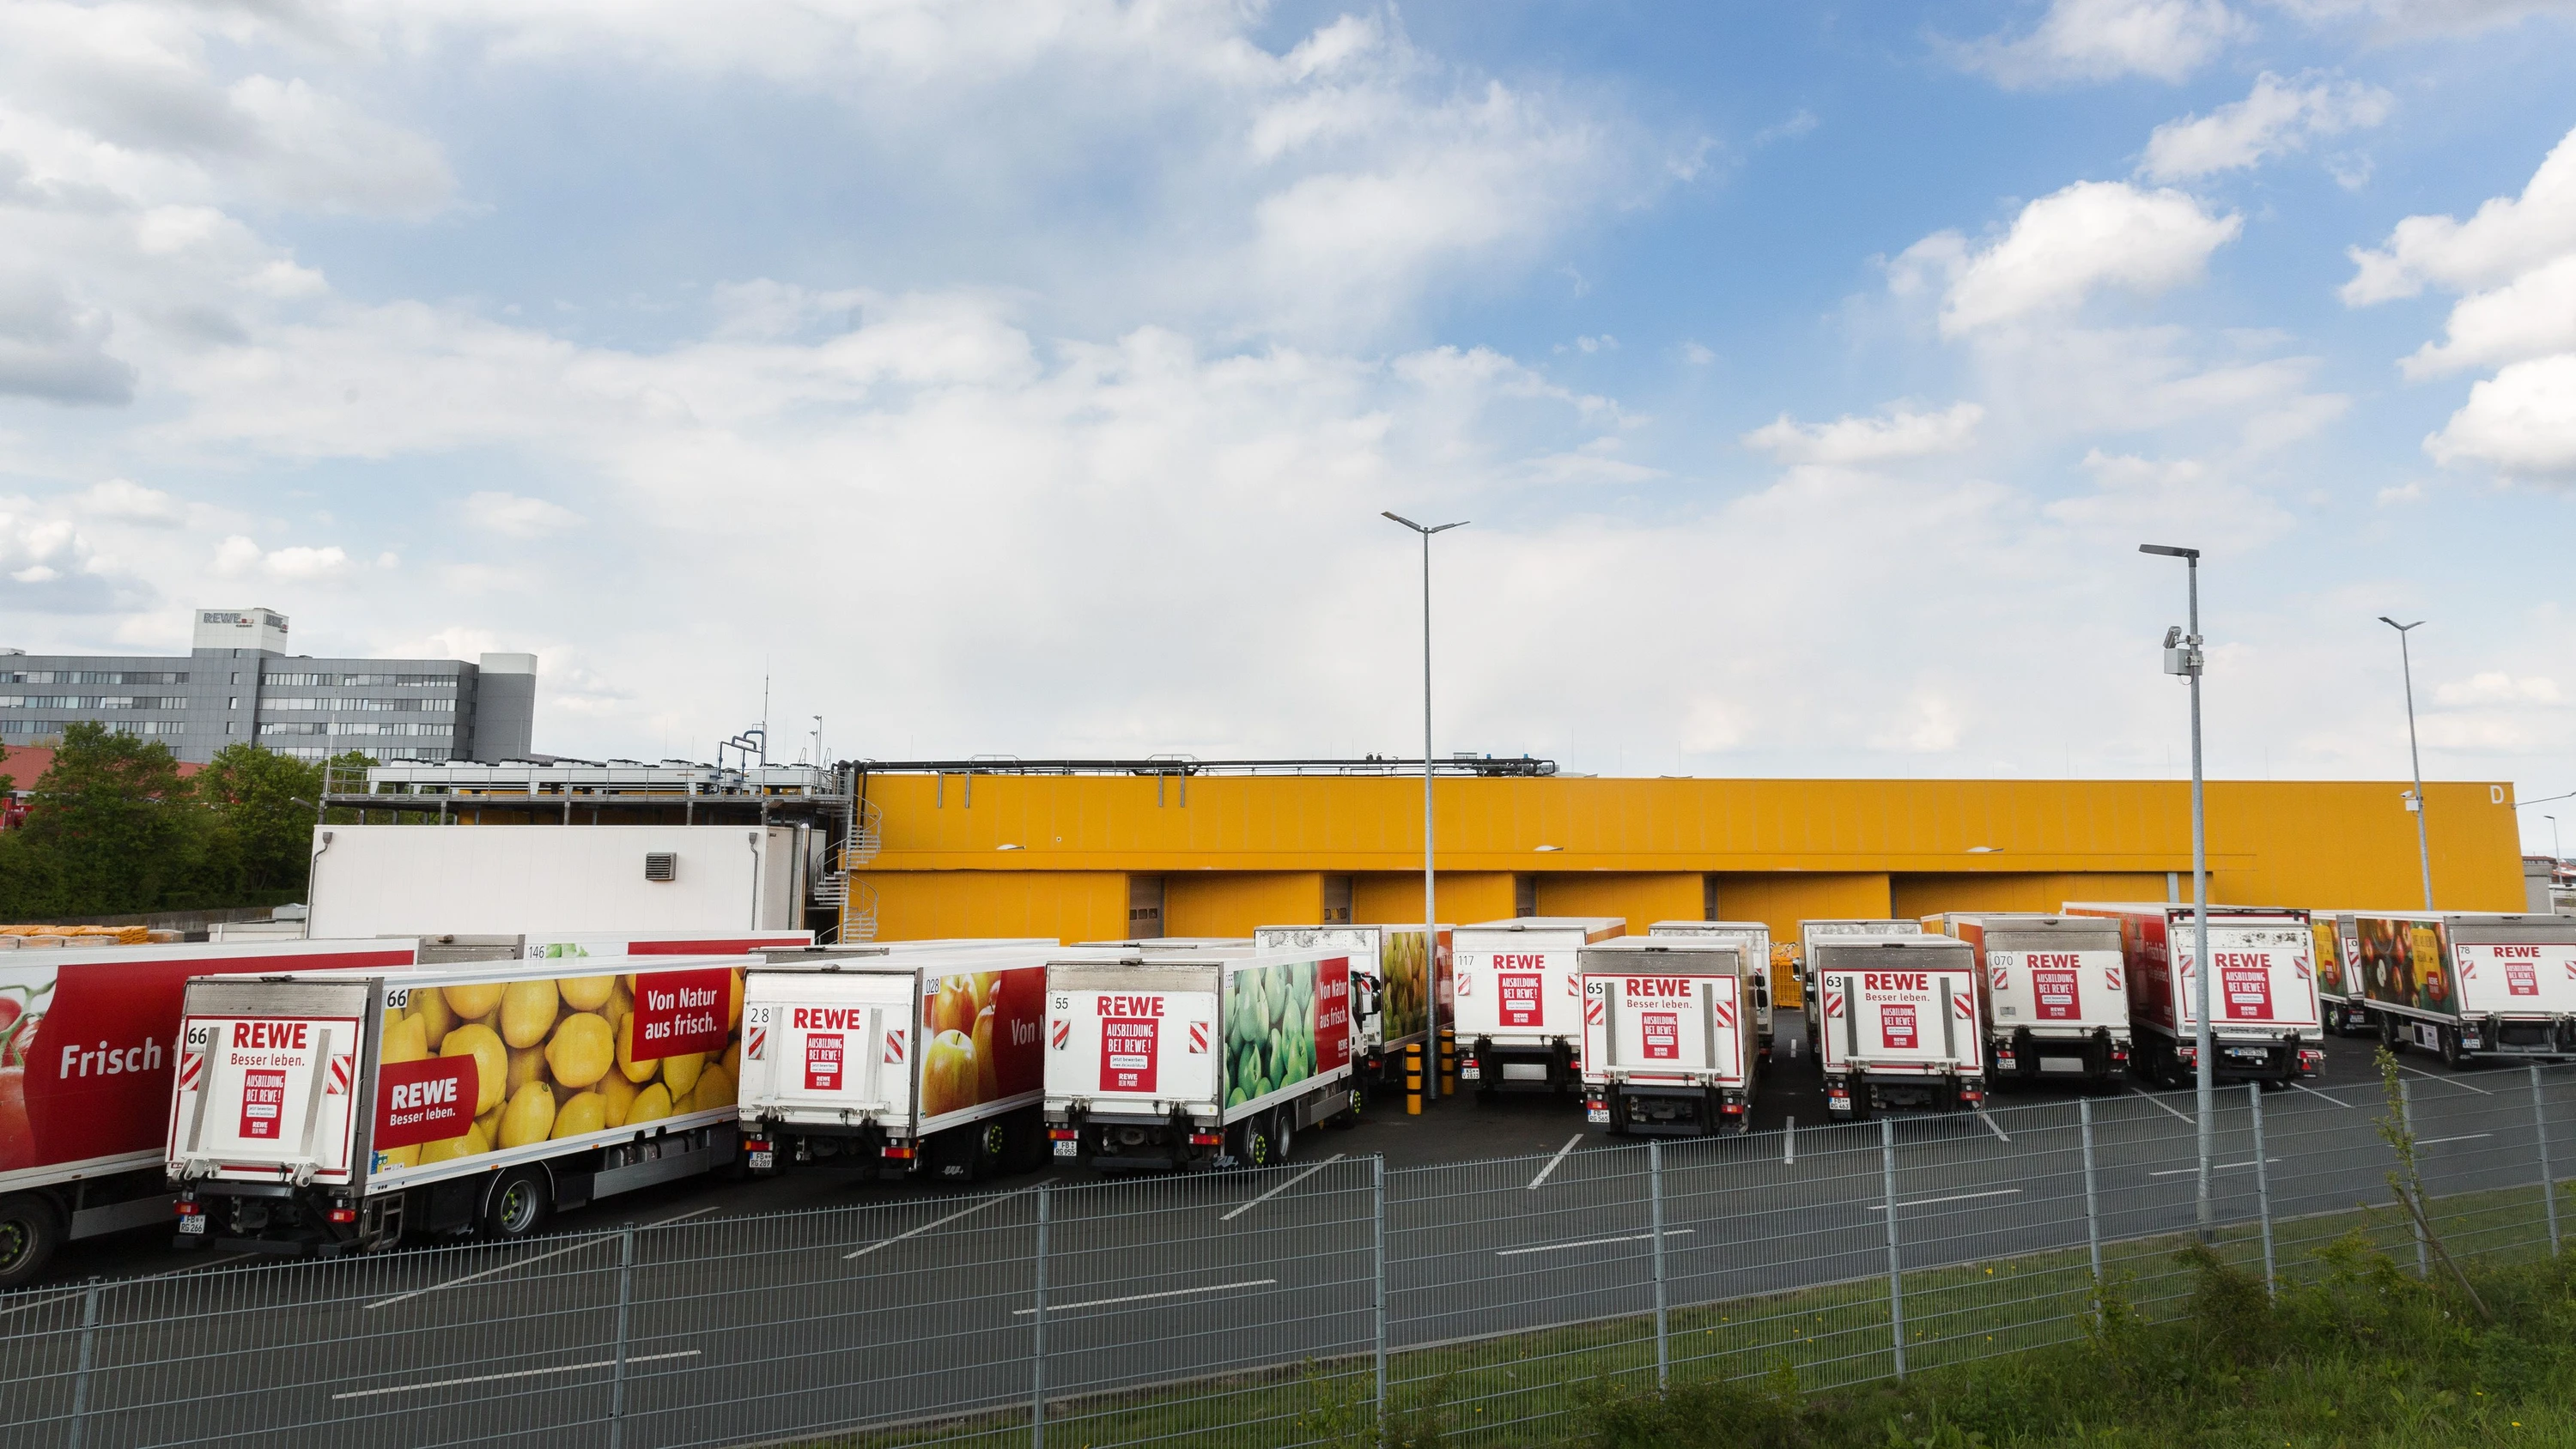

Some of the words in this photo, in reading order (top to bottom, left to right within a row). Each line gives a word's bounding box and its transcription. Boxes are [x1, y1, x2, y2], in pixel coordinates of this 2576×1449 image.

[204, 613, 241, 623] REWE
[2490, 785, 2504, 803] D
[529, 945, 544, 959] 146
[2494, 947, 2541, 957] REWE
[1459, 955, 1474, 966] 117
[1493, 955, 1546, 969] REWE
[1994, 955, 2014, 966] 070
[2026, 955, 2081, 968] REWE
[2215, 953, 2272, 967] REWE
[1502, 978, 1539, 987] AUSBILDUNG
[1826, 976, 1842, 987] 63
[1864, 973, 1929, 991] REWE
[2037, 973, 2074, 983] AUSBILDUNG
[2226, 972, 2265, 981] AUSBILDUNG
[926, 978, 939, 994] 028
[1320, 981, 1330, 1000] Von
[1332, 979, 1347, 997] Natur
[1587, 982, 1603, 994] 65
[1626, 979, 1692, 997] REWE
[2038, 984, 2050, 993] BEI
[2228, 982, 2240, 992] BEI
[387, 990, 406, 1008] 66
[647, 990, 675, 1011] Von
[679, 987, 717, 1008] Natur
[1504, 988, 1515, 998] BEI
[1900, 993, 1929, 1002] leben.
[1055, 997, 1068, 1009] 55
[1097, 996, 1164, 1016] REWE
[1627, 999, 1658, 1008] Besser
[1662, 1000, 1692, 1009] leben.
[793, 1008, 860, 1029] REWE
[1320, 1014, 1329, 1029] aus
[1331, 1005, 1347, 1026] frisch.
[1882, 1008, 1915, 1016] AUSBILDUNG
[645, 1021, 671, 1040] aus
[674, 1011, 717, 1036] frisch.
[1643, 1016, 1676, 1025] AUSBILDUNG
[1884, 1017, 1893, 1026] BEI
[188, 1028, 207, 1045] 66
[233, 1022, 307, 1049] REWE
[1012, 1018, 1035, 1046] Von
[1107, 1024, 1153, 1037] AUSBILDUNG
[1645, 1026, 1655, 1034] BEI
[808, 1038, 842, 1049] AUSBILDUNG
[1108, 1039, 1121, 1052] BEI
[60, 1037, 161, 1079] Frisch
[230, 1053, 267, 1065] Besser
[270, 1053, 305, 1066] leben.
[809, 1049, 819, 1060] BEI
[246, 1075, 284, 1088] AUSBILDUNG
[246, 1089, 258, 1102] BEI
[392, 1077, 458, 1110] REWE
[390, 1113, 424, 1126] Besser
[426, 1107, 456, 1120] leben.
[191, 1224, 203, 1233] 266
